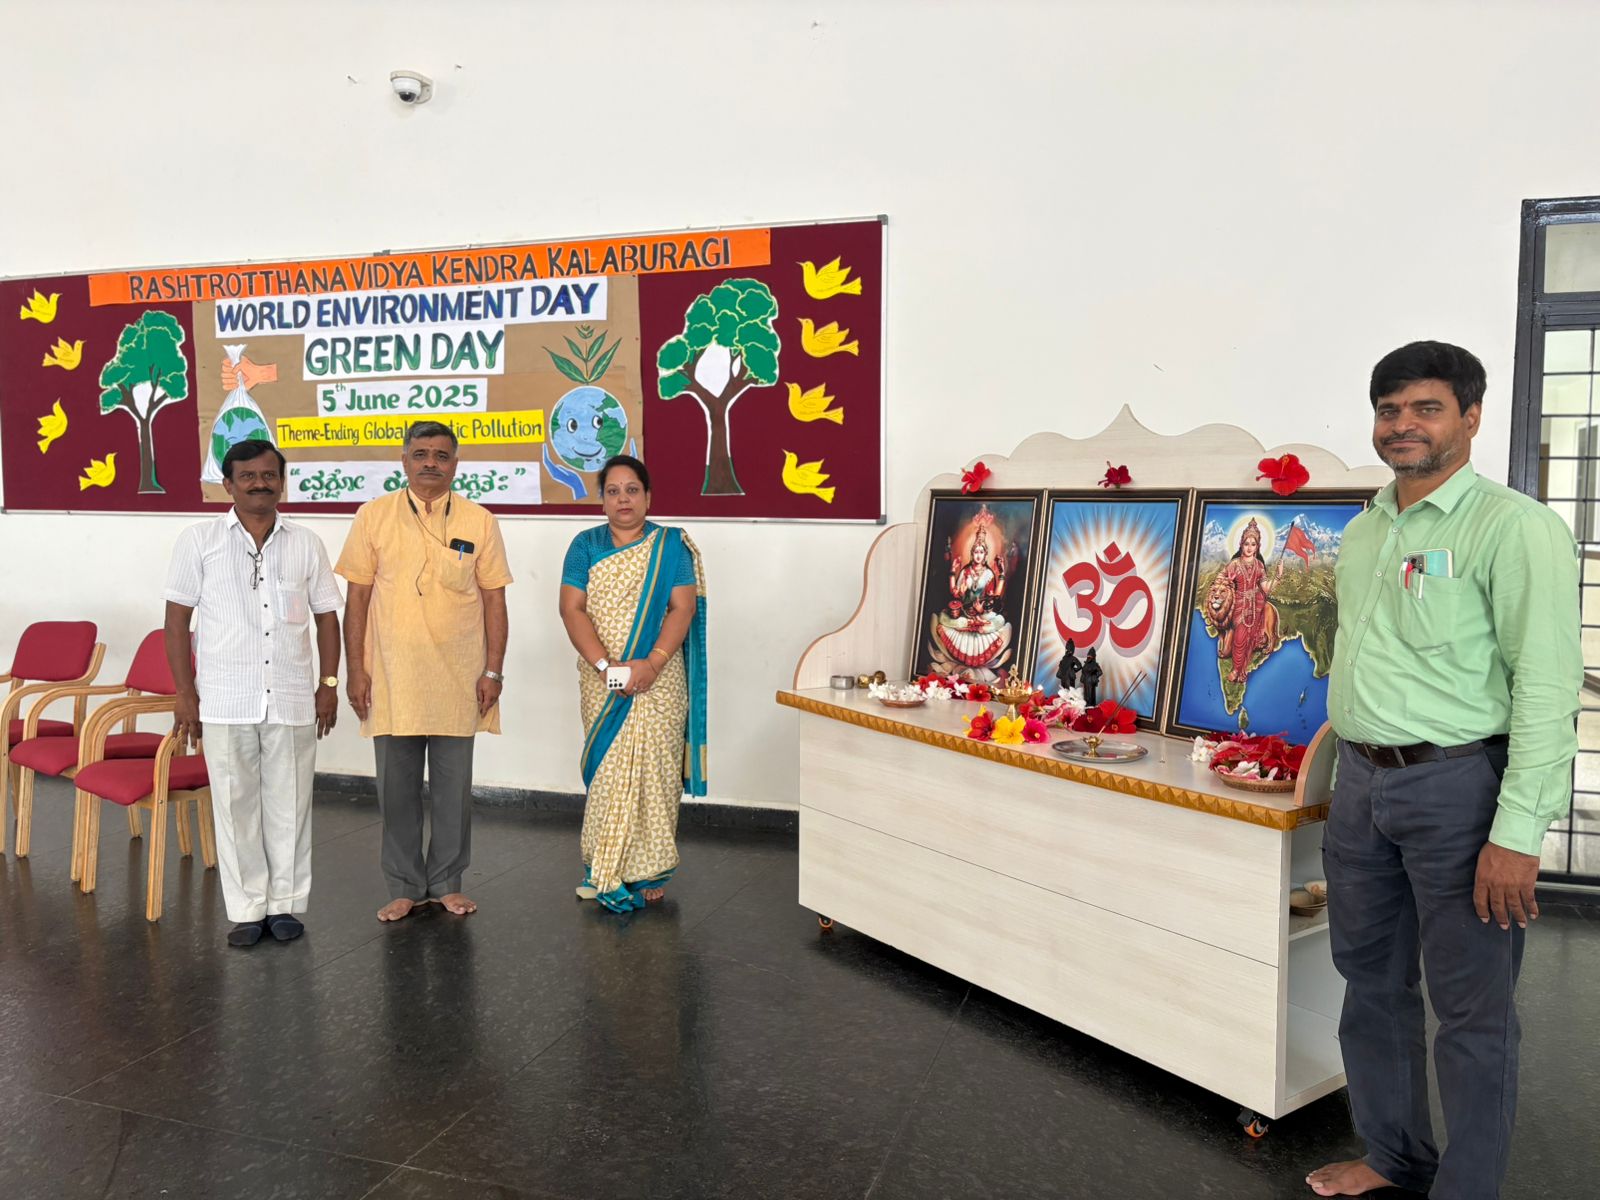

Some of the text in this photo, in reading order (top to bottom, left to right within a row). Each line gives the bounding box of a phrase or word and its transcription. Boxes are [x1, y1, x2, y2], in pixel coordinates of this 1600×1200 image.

[129, 237, 731, 301] RASHTROTTHANA VIDYA KENDRA KALABURAGI
[216, 282, 600, 333] WORLD ENVIRONMENT DAY
[304, 329, 505, 377] GREEN DAY
[322, 383, 479, 412] 5th June 2025
[277, 422, 360, 446] Theme-Ending
[472, 417, 543, 440] Pollution
